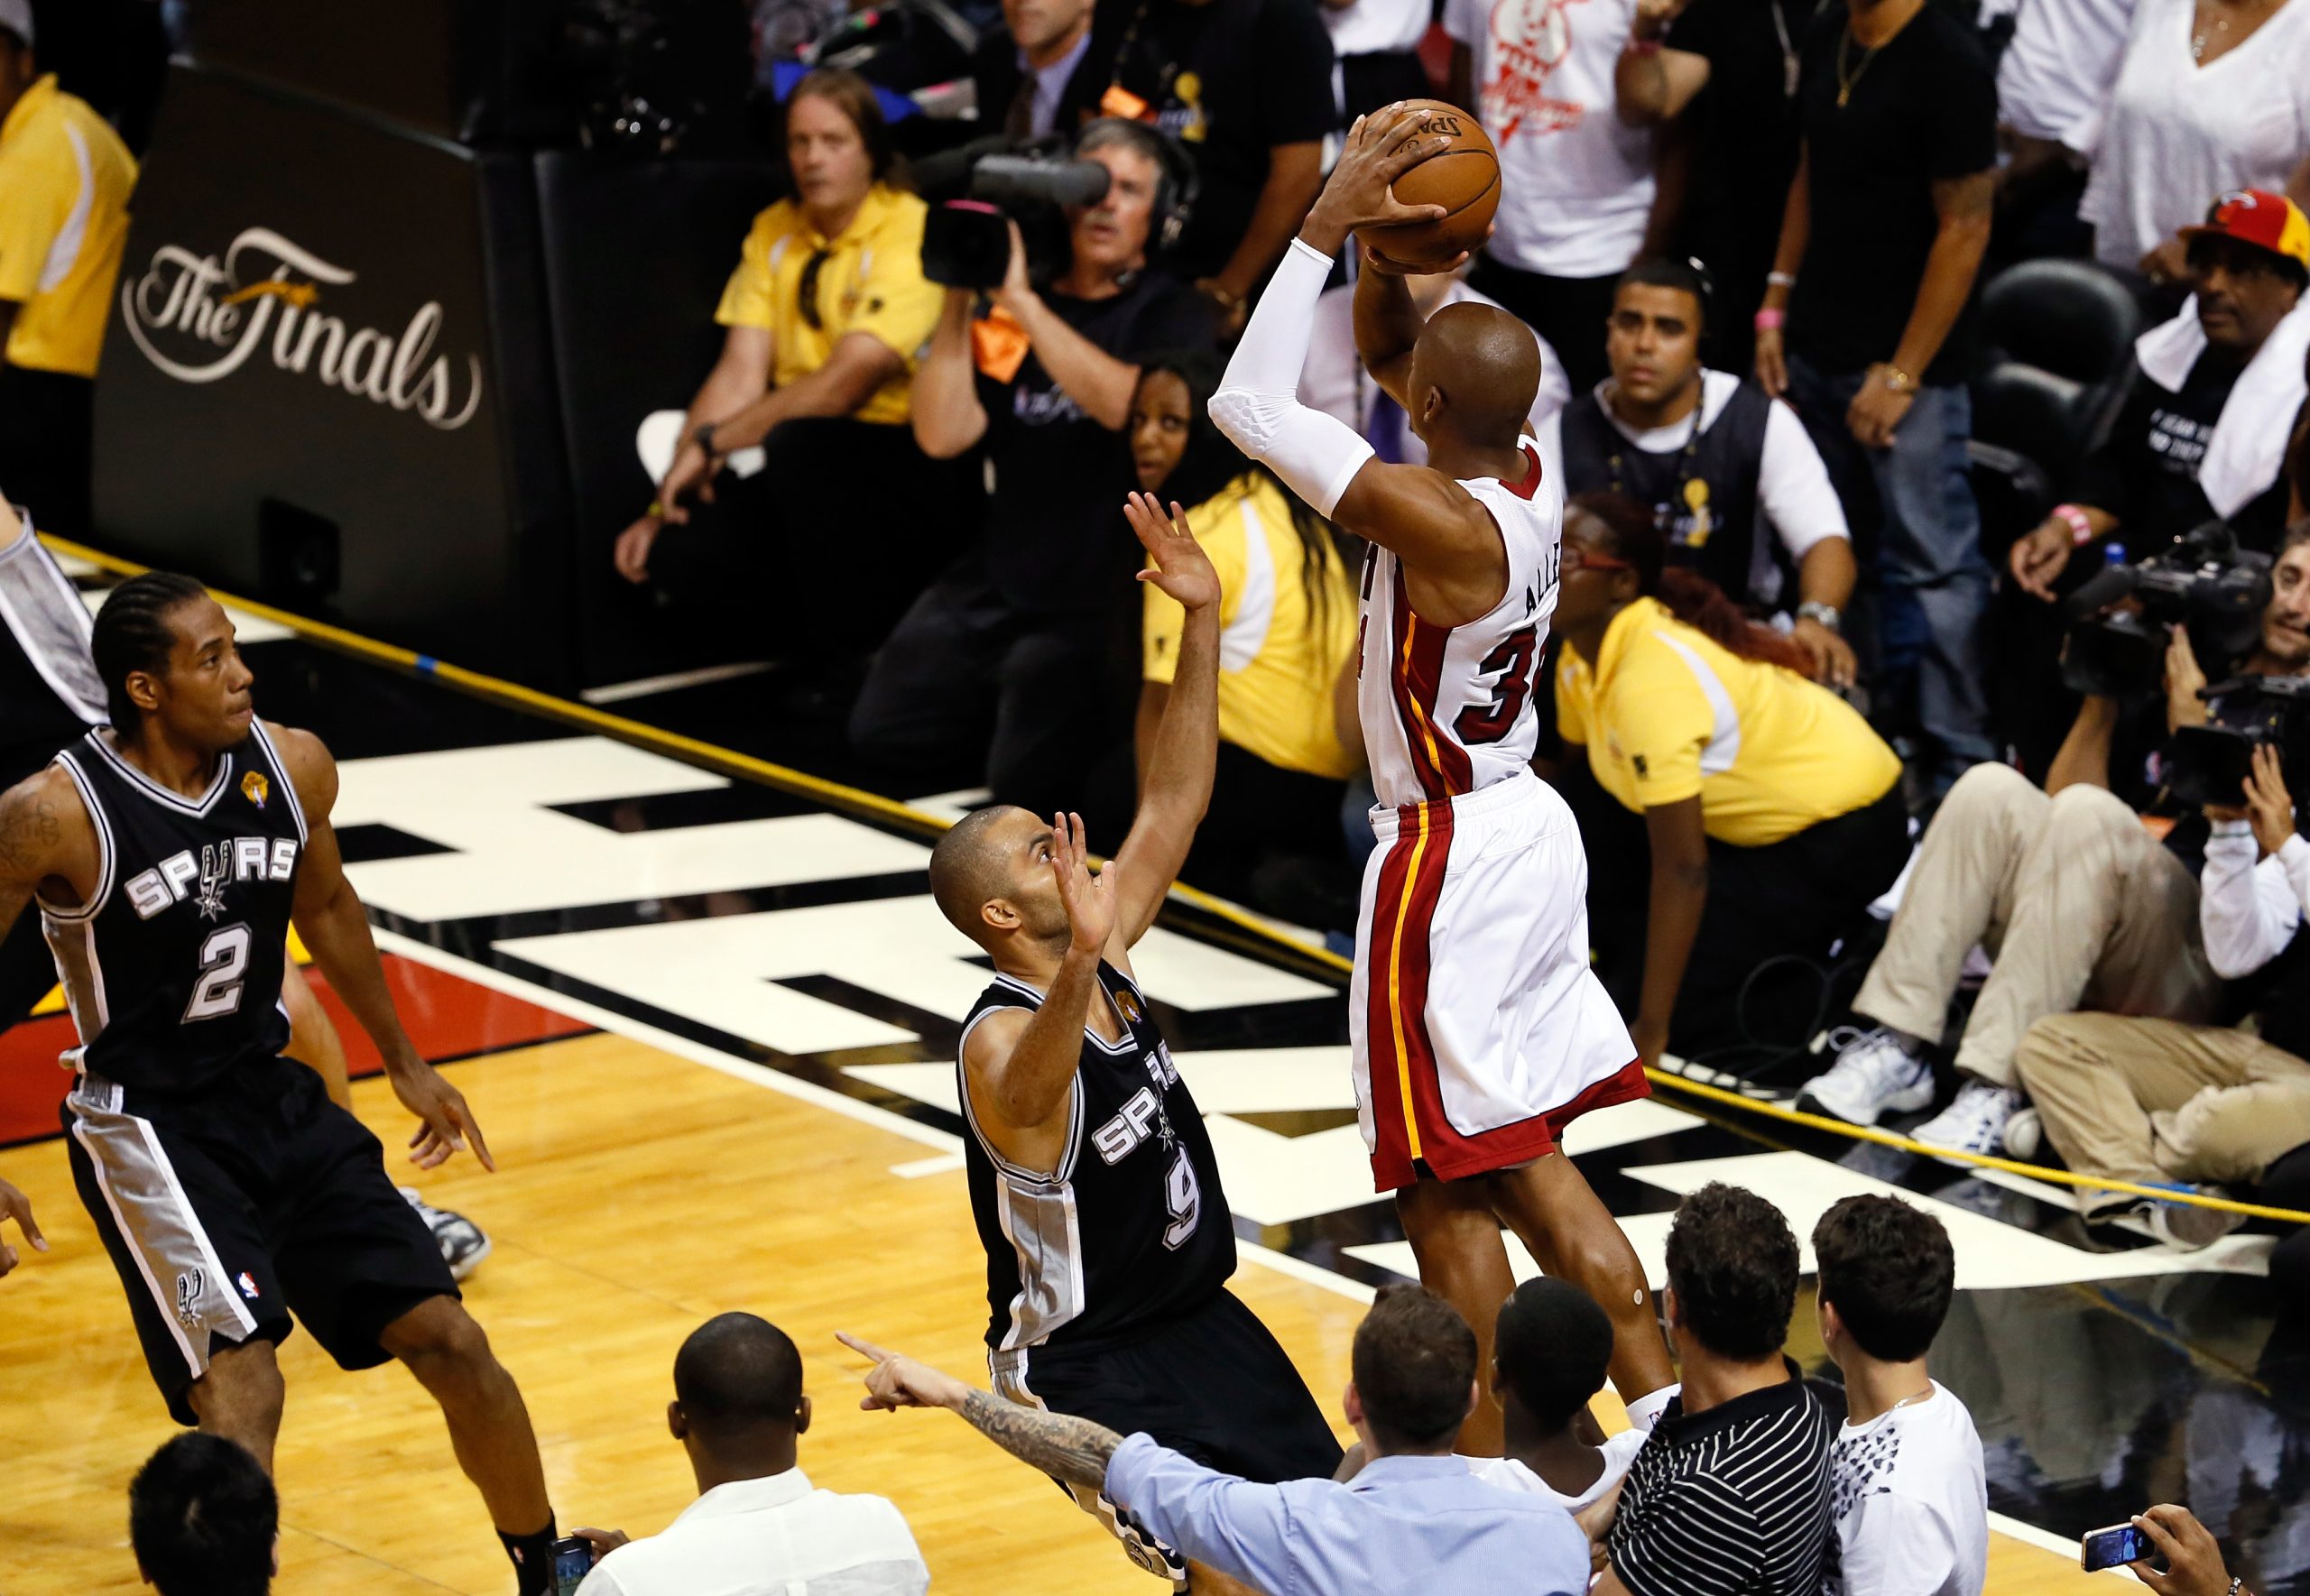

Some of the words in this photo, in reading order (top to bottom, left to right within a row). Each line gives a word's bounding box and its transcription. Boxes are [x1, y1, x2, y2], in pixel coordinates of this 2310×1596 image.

[1418, 116, 1462, 137] SPA
[122, 226, 482, 431] Finals
[137, 244, 240, 346] The
[124, 836, 298, 924] SPURS
[180, 920, 253, 1025] 2
[1091, 1038, 1178, 1166] SPRS
[1162, 1139, 1202, 1251] 9
